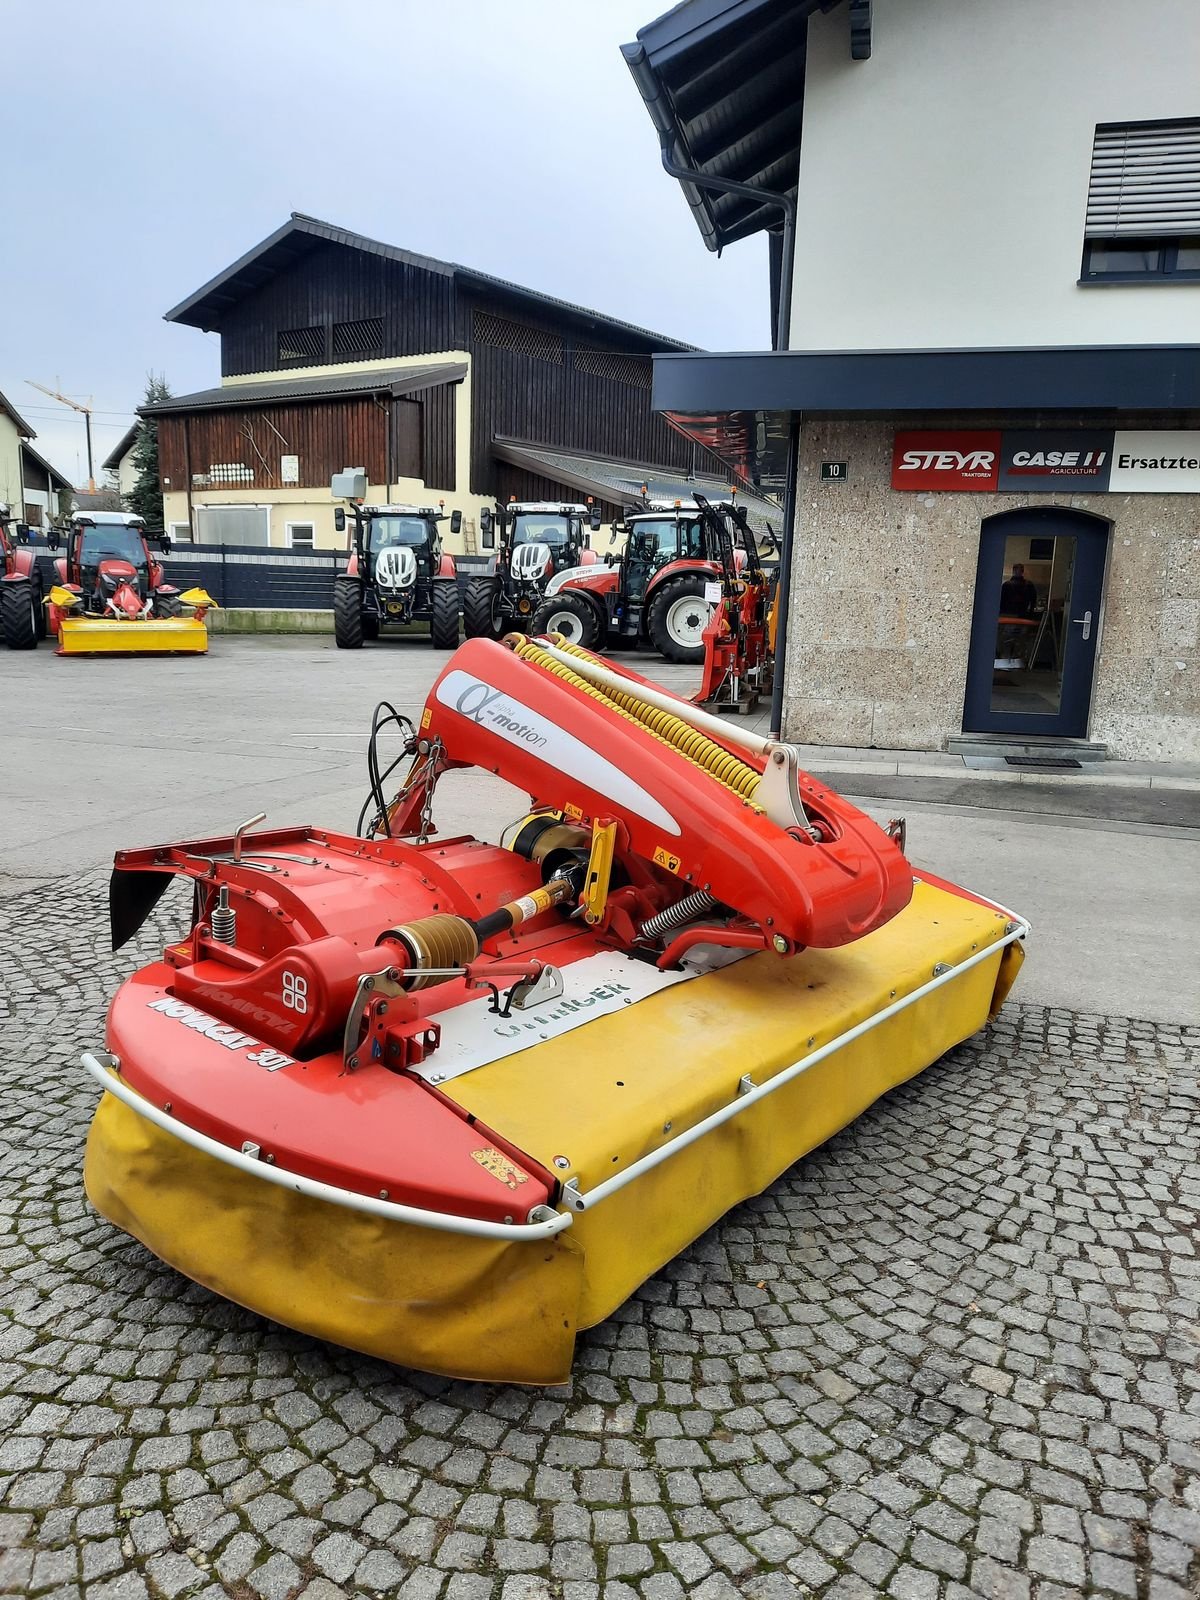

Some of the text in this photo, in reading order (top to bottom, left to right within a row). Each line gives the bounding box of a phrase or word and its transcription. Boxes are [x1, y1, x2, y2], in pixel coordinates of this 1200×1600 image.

[898, 450, 995, 471] STEYR
[1012, 451, 1081, 467] CASE
[1118, 454, 1200, 469] Ersatzte
[829, 464, 840, 476] 10
[146, 997, 297, 1073] NOVACAT 301
